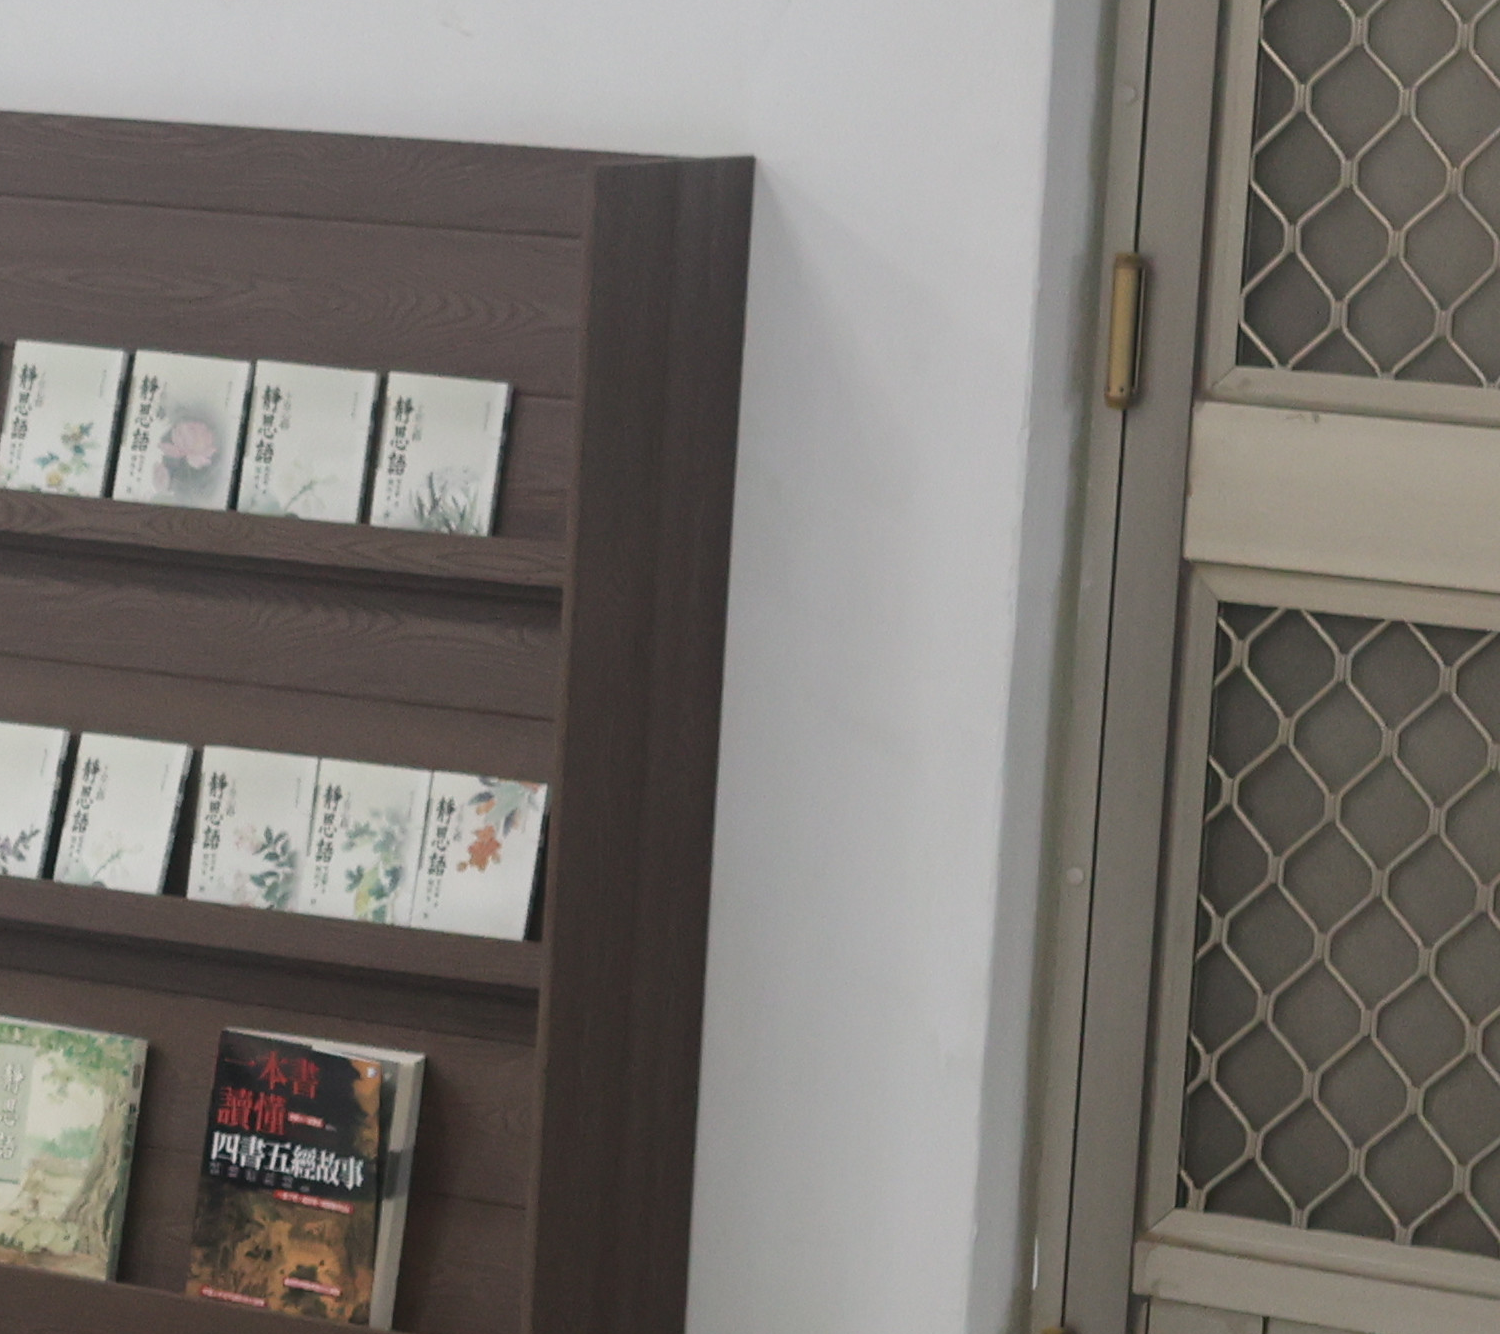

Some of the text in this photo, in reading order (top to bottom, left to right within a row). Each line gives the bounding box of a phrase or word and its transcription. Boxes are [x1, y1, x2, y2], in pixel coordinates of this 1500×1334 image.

[224, 1050, 320, 1100] 一本書
[216, 1085, 288, 1137] 讀懂
[210, 1130, 365, 1191] 四書五經故事
